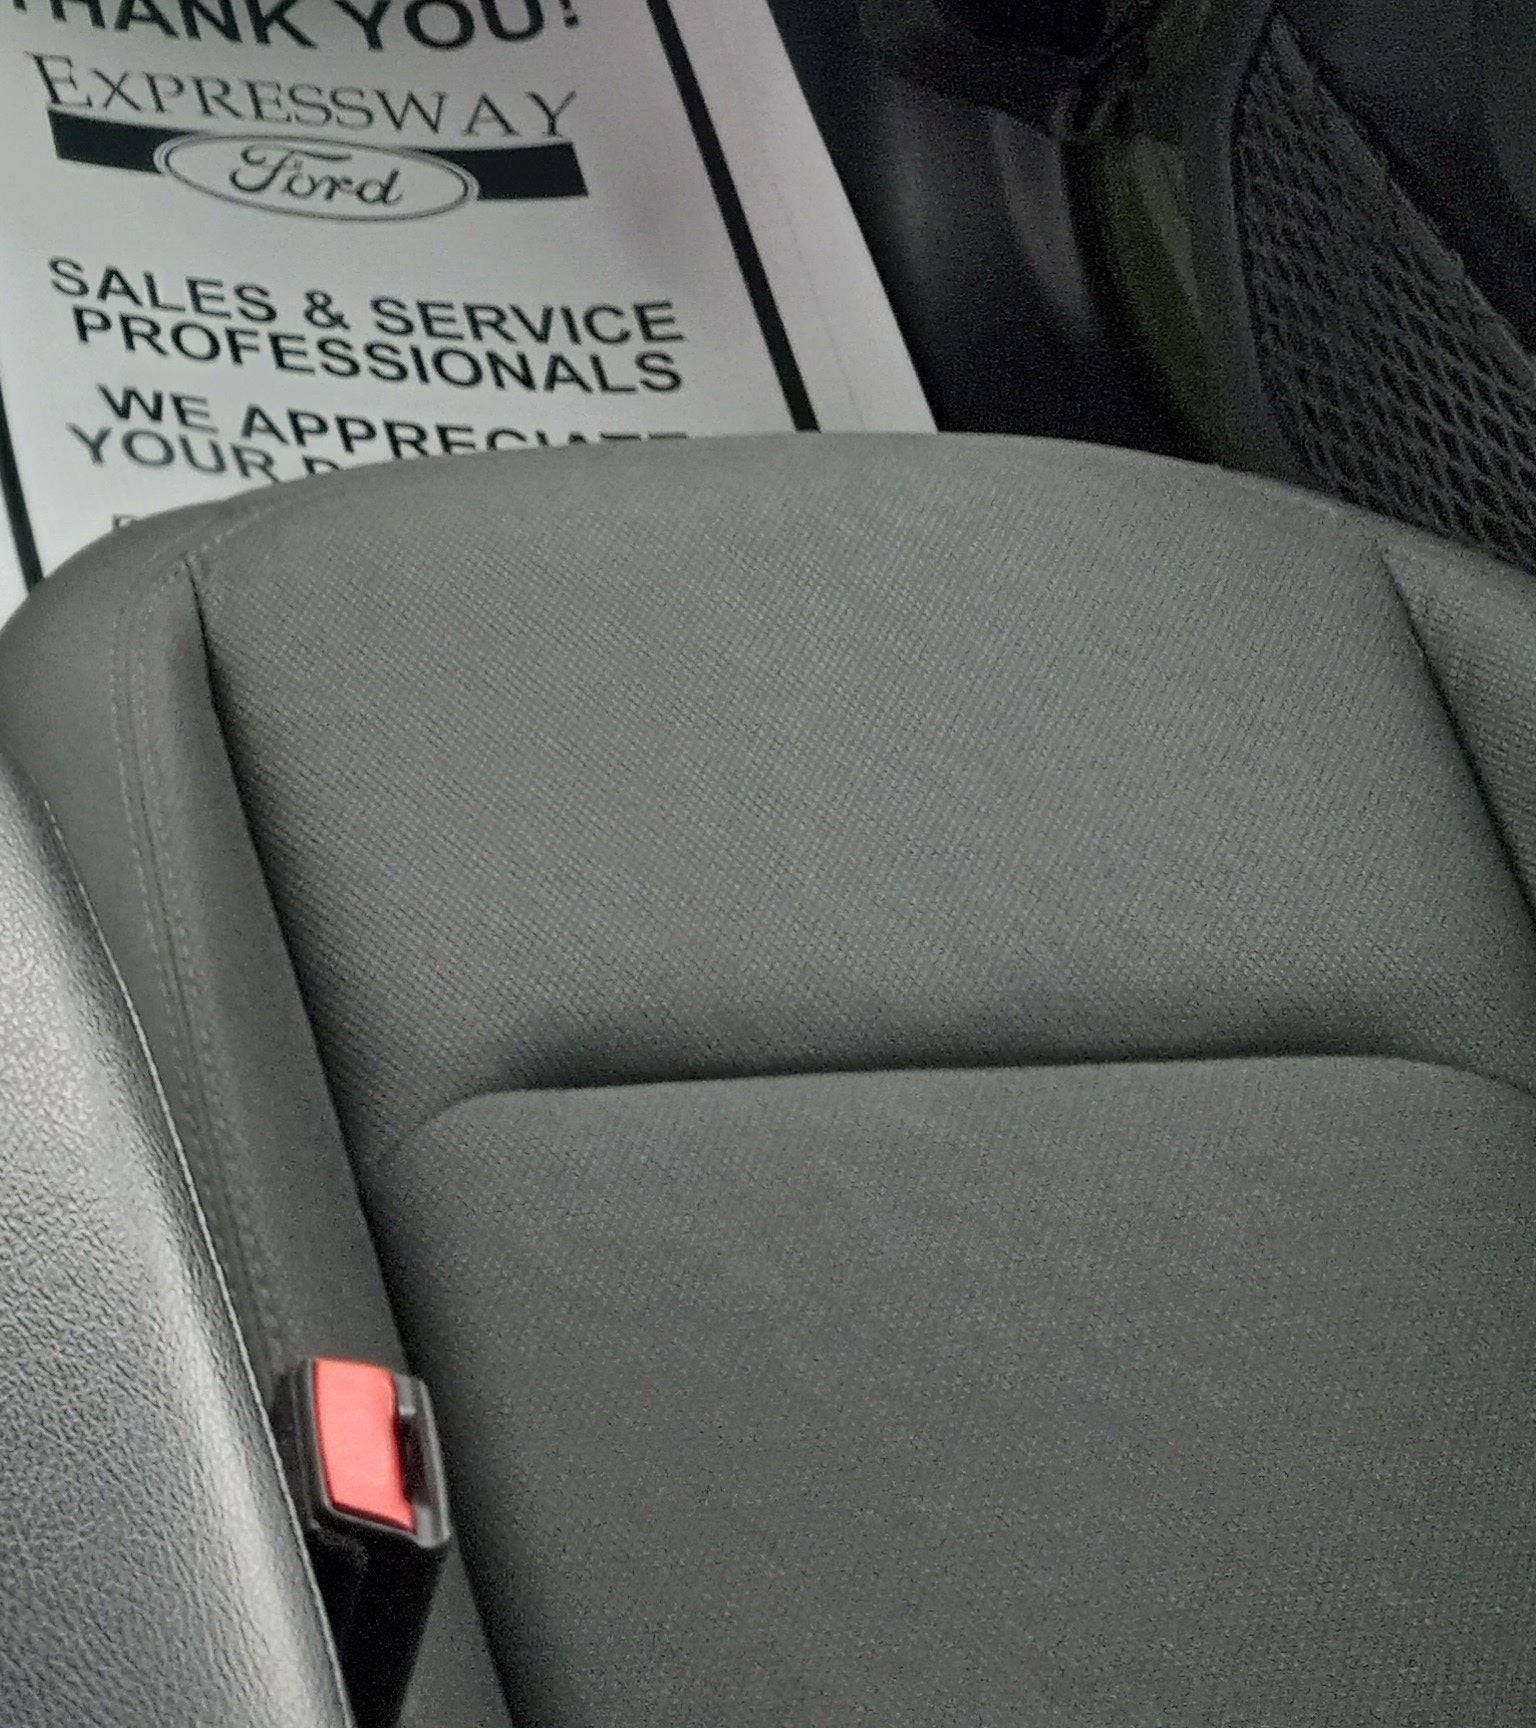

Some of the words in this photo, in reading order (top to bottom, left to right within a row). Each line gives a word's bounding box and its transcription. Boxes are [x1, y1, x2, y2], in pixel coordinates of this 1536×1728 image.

[29, 51, 578, 138] EXPRESSWAY
[229, 144, 405, 208] Ford
[48, 257, 281, 325] SALES
[303, 288, 351, 331] &
[370, 296, 686, 346] SERVICE
[72, 304, 684, 394] PROFESSIONALS
[96, 383, 219, 435] WE
[67, 423, 282, 483] YOUR
